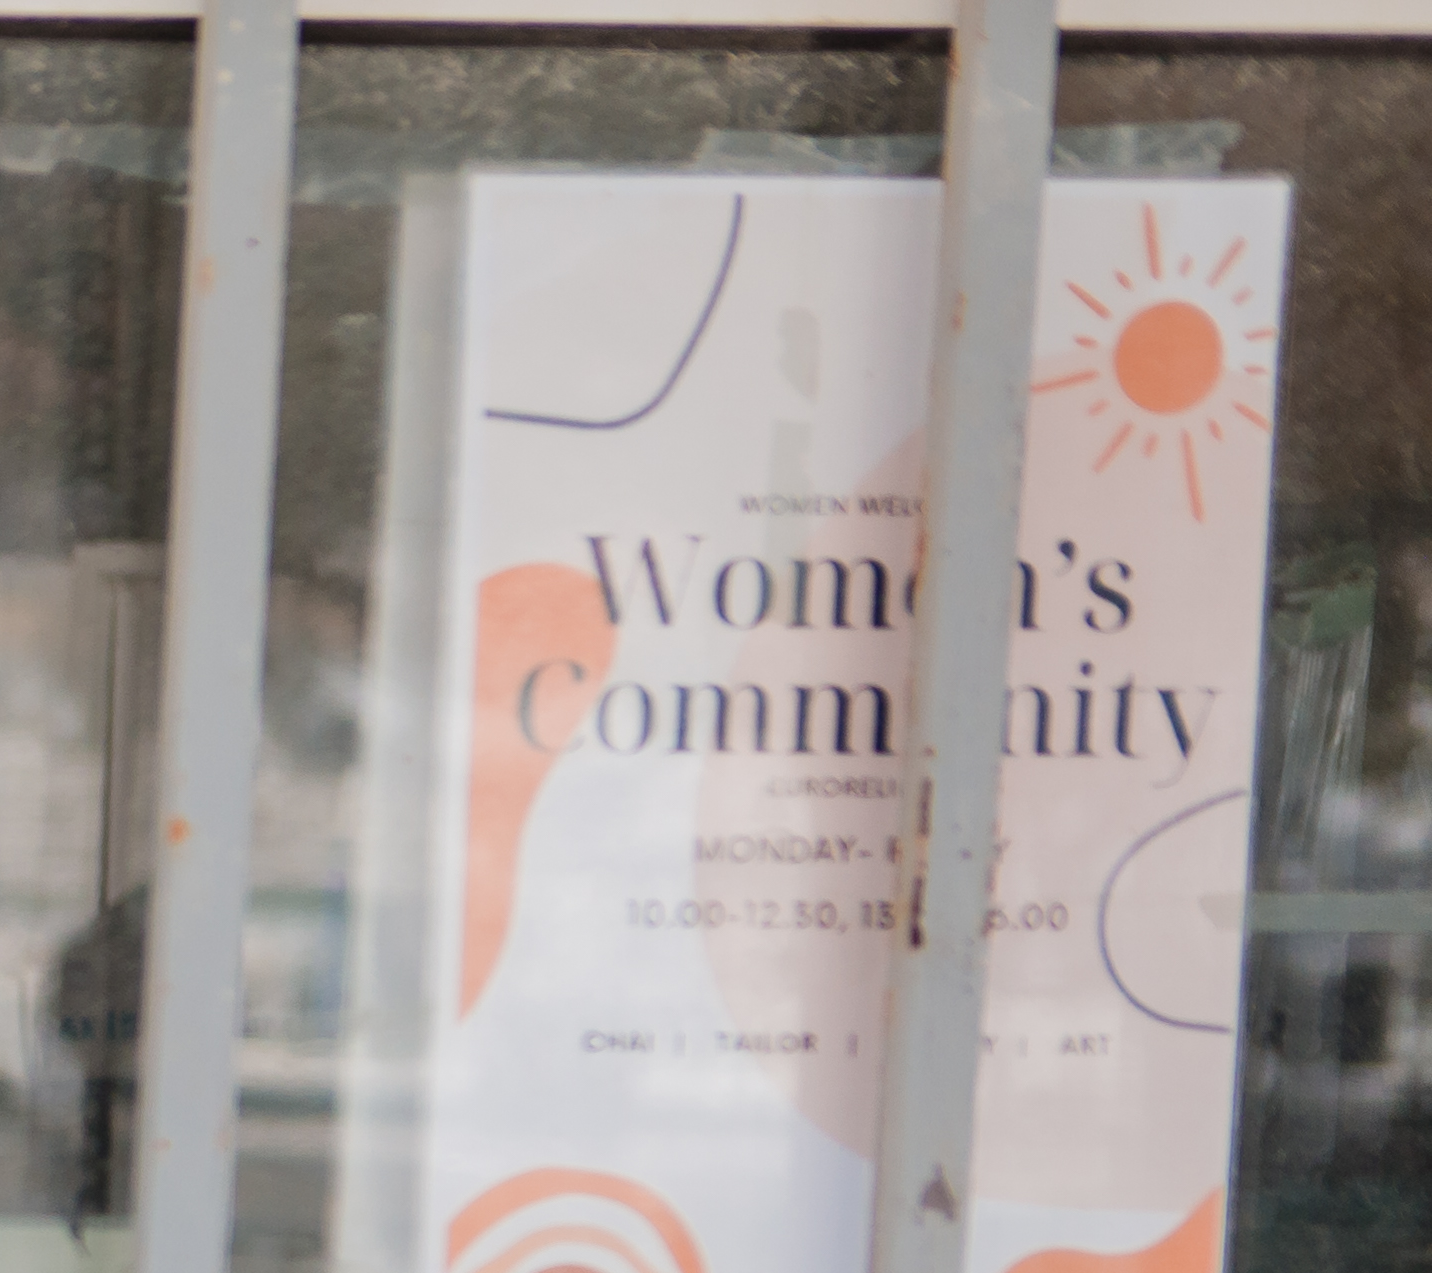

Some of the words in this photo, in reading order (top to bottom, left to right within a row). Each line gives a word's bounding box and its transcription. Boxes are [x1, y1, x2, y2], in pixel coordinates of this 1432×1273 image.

[738, 494, 849, 517] WOMEN
[584, 533, 1136, 632] Womn's
[516, 654, 1222, 788] Commnity
[582, 1029, 654, 1056] CHAI
[716, 1029, 818, 1056] TAILOR
[1059, 1029, 1112, 1055] ART
